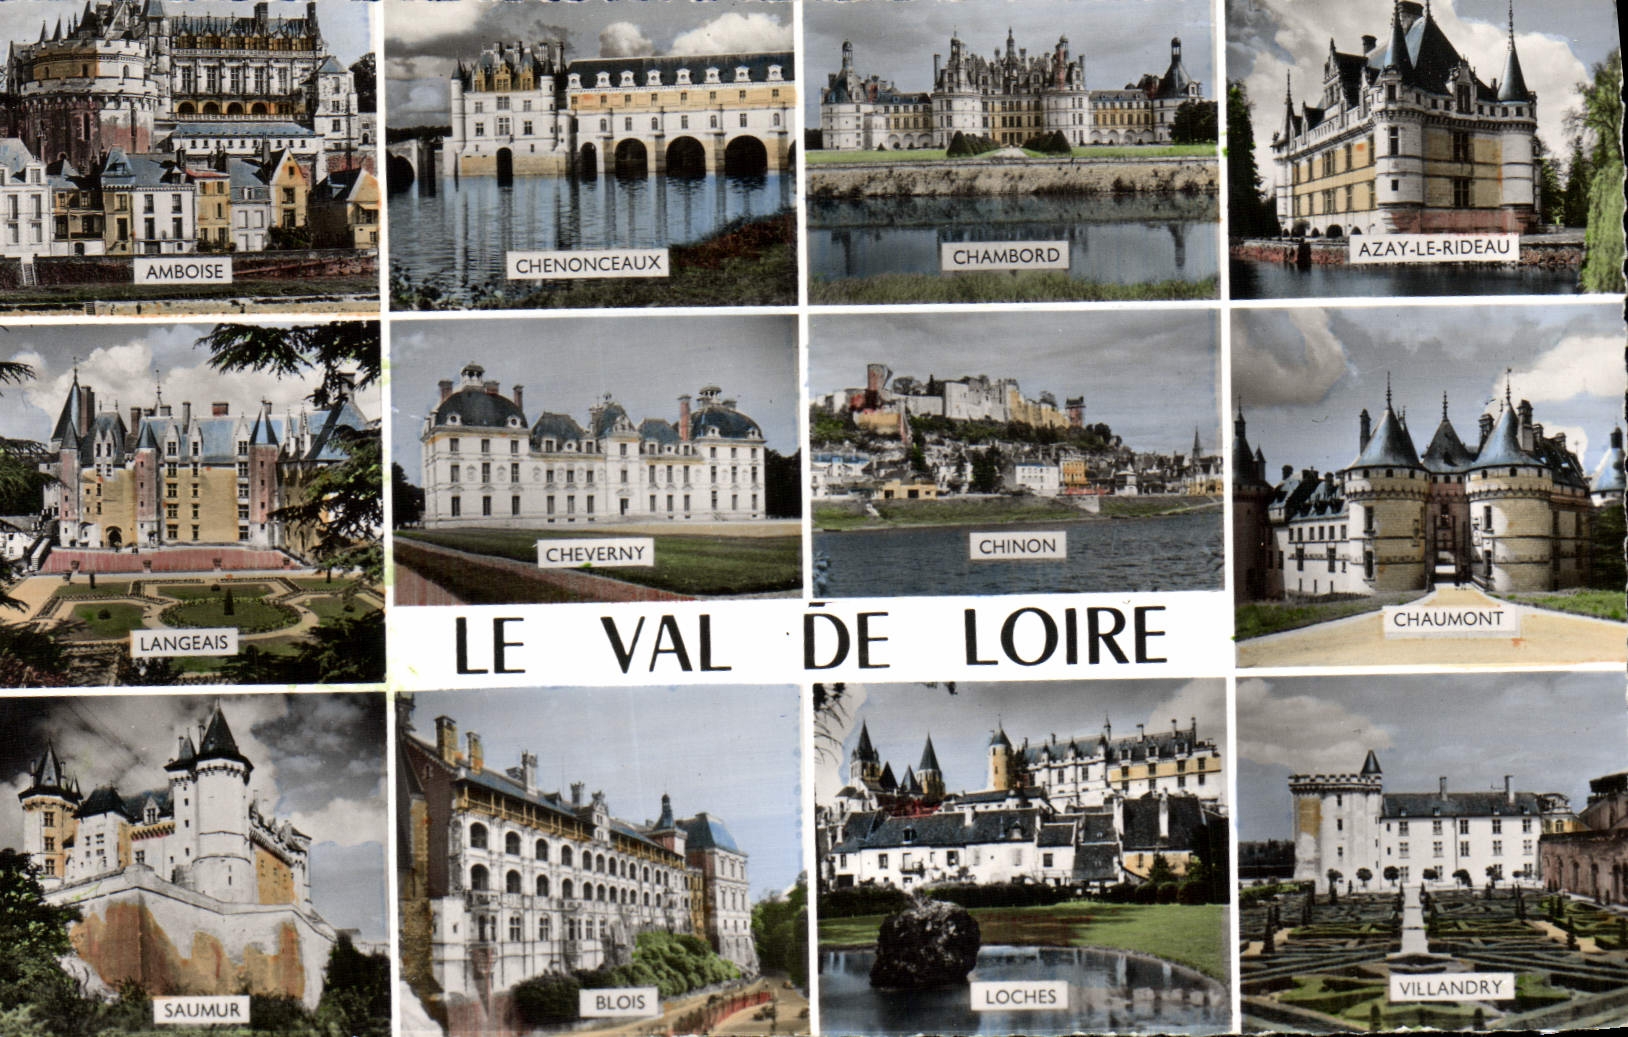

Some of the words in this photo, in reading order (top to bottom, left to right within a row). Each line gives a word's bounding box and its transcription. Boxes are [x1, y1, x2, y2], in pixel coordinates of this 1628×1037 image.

[953, 248, 1060, 265] CHAMBORD
[1359, 240, 1510, 258] AZAY-LE-RIDEAU
[146, 264, 223, 279] AMBOISE
[516, 256, 661, 274] CHENONCEAUX
[546, 546, 645, 563] CHEVERNY
[979, 538, 1056, 555] CHINON
[1394, 611, 1503, 628] CHAUMONT
[140, 634, 229, 652] LANGEAIS
[455, 617, 526, 675] LE
[601, 615, 732, 674] VAL
[804, 612, 891, 670] DE
[965, 606, 1168, 667] LOIRE
[986, 989, 1057, 1005] LOCHES
[1400, 980, 1502, 997] VILLANDRY
[164, 1002, 241, 1018] SAUMUR
[596, 993, 646, 1011] BLOIS
